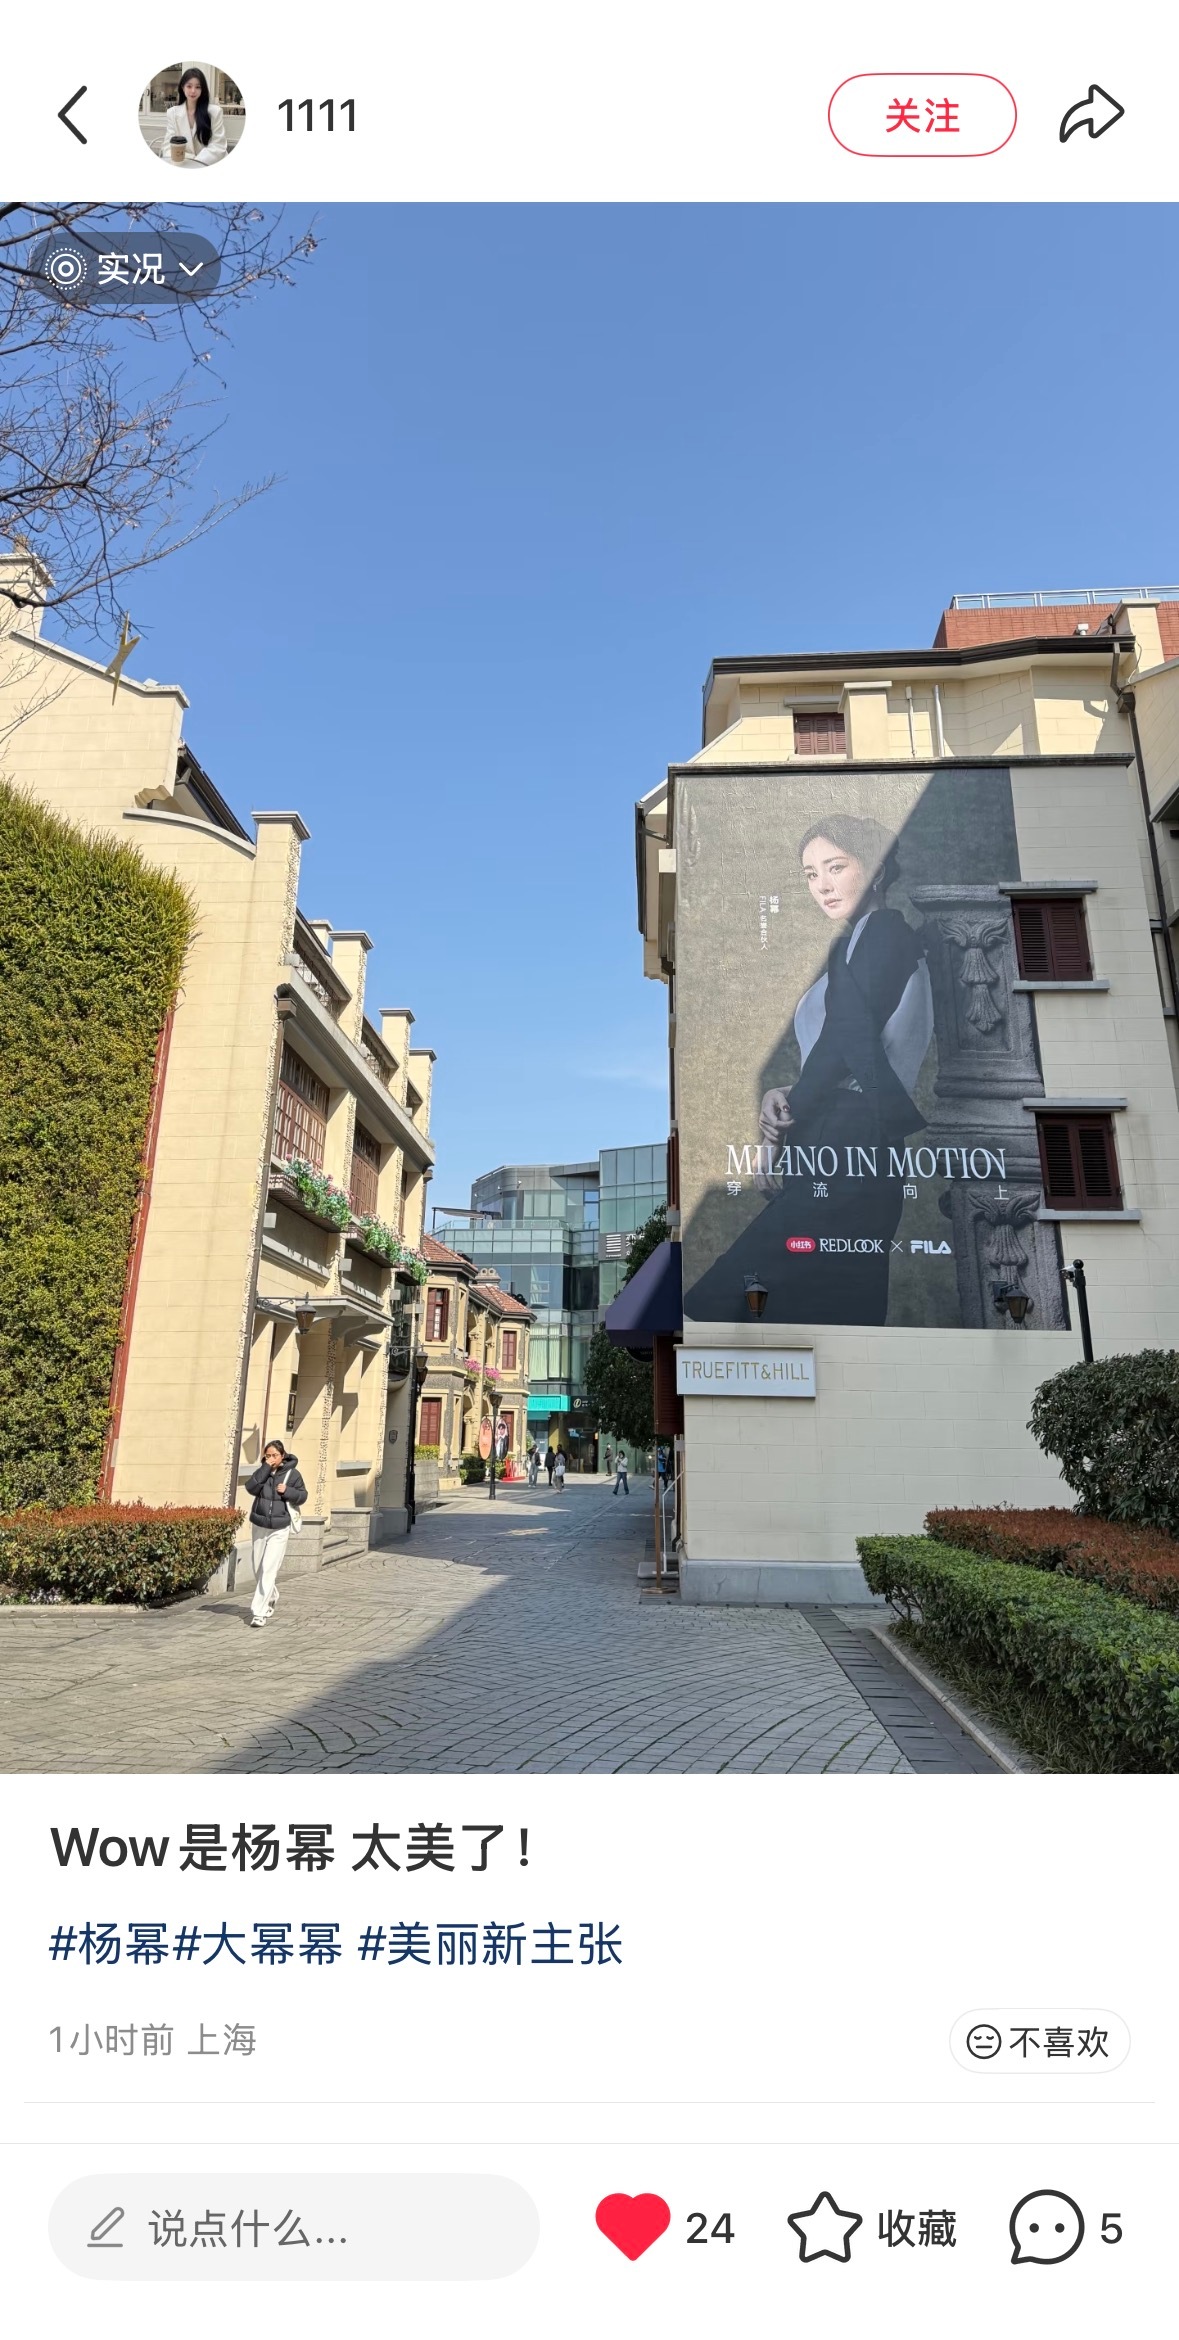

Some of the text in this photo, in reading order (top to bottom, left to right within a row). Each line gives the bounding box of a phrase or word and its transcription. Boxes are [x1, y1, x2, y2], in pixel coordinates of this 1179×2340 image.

[725, 1144, 1007, 1180] MILANO IN MOTION
[819, 1238, 885, 1254] REDLOOK
[910, 1239, 952, 1255] FILA
[681, 1360, 810, 1381] TRUEFITT&HILL
